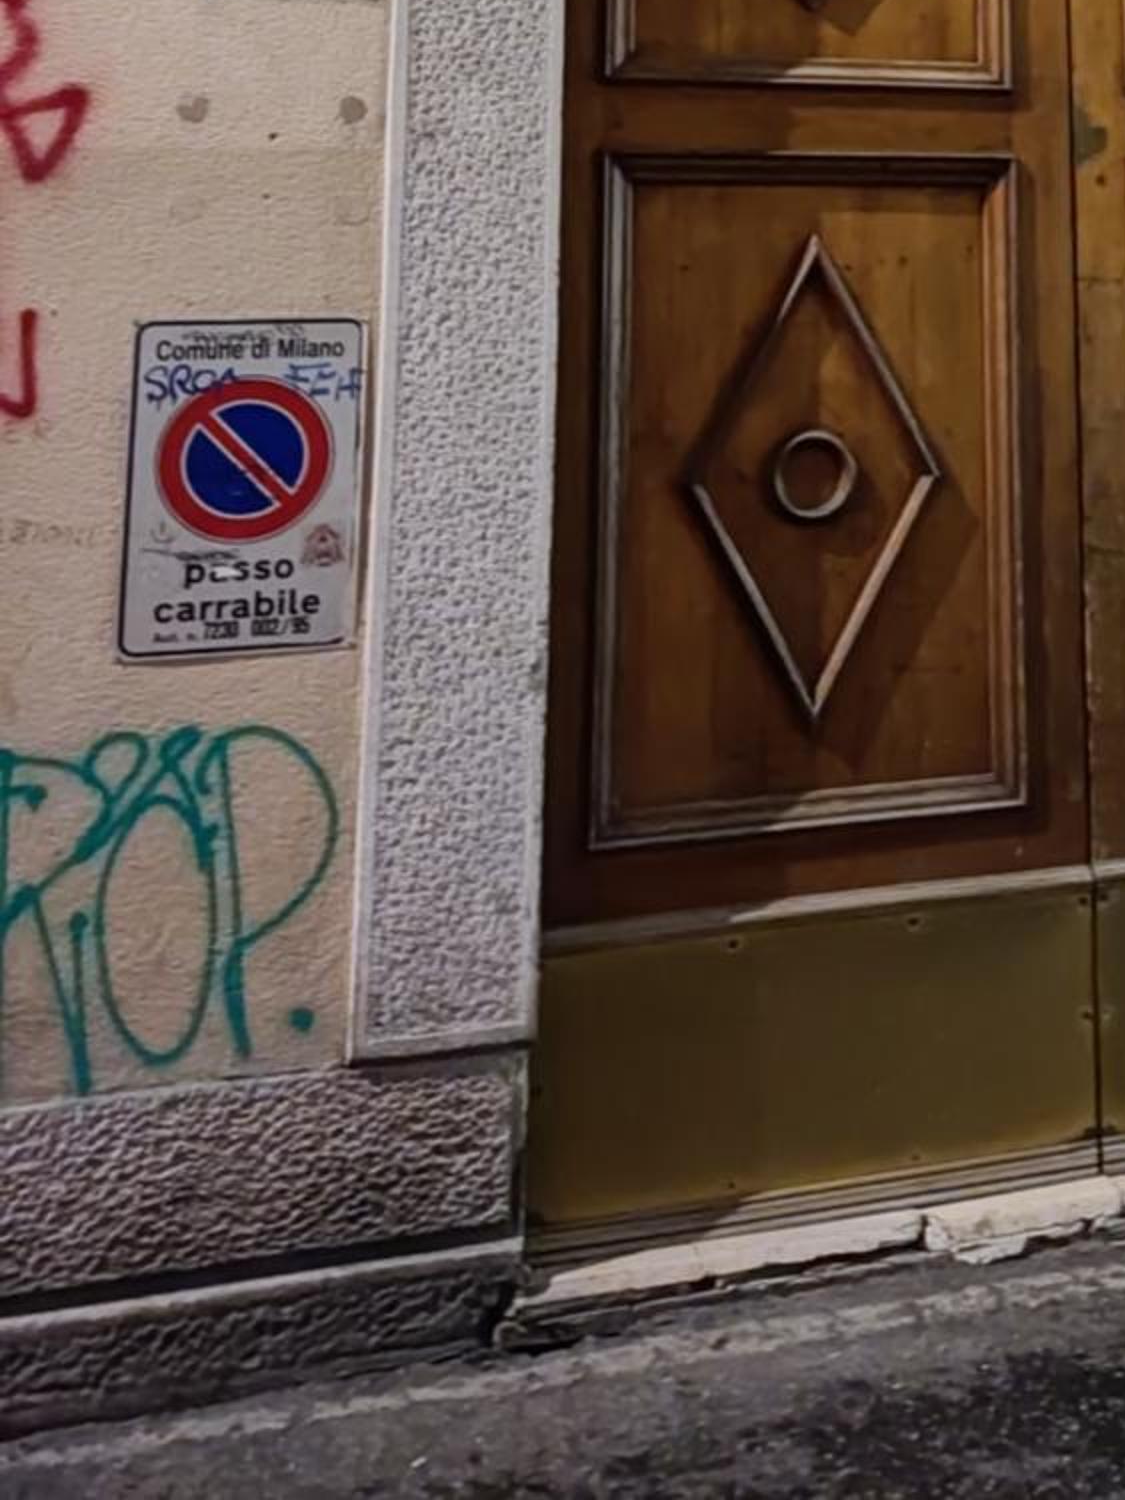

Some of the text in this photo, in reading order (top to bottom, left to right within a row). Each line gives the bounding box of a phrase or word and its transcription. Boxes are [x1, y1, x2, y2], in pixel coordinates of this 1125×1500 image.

[156, 337, 345, 362] Comune di Milano
[184, 557, 295, 590] passo
[153, 589, 321, 624] carrabile
